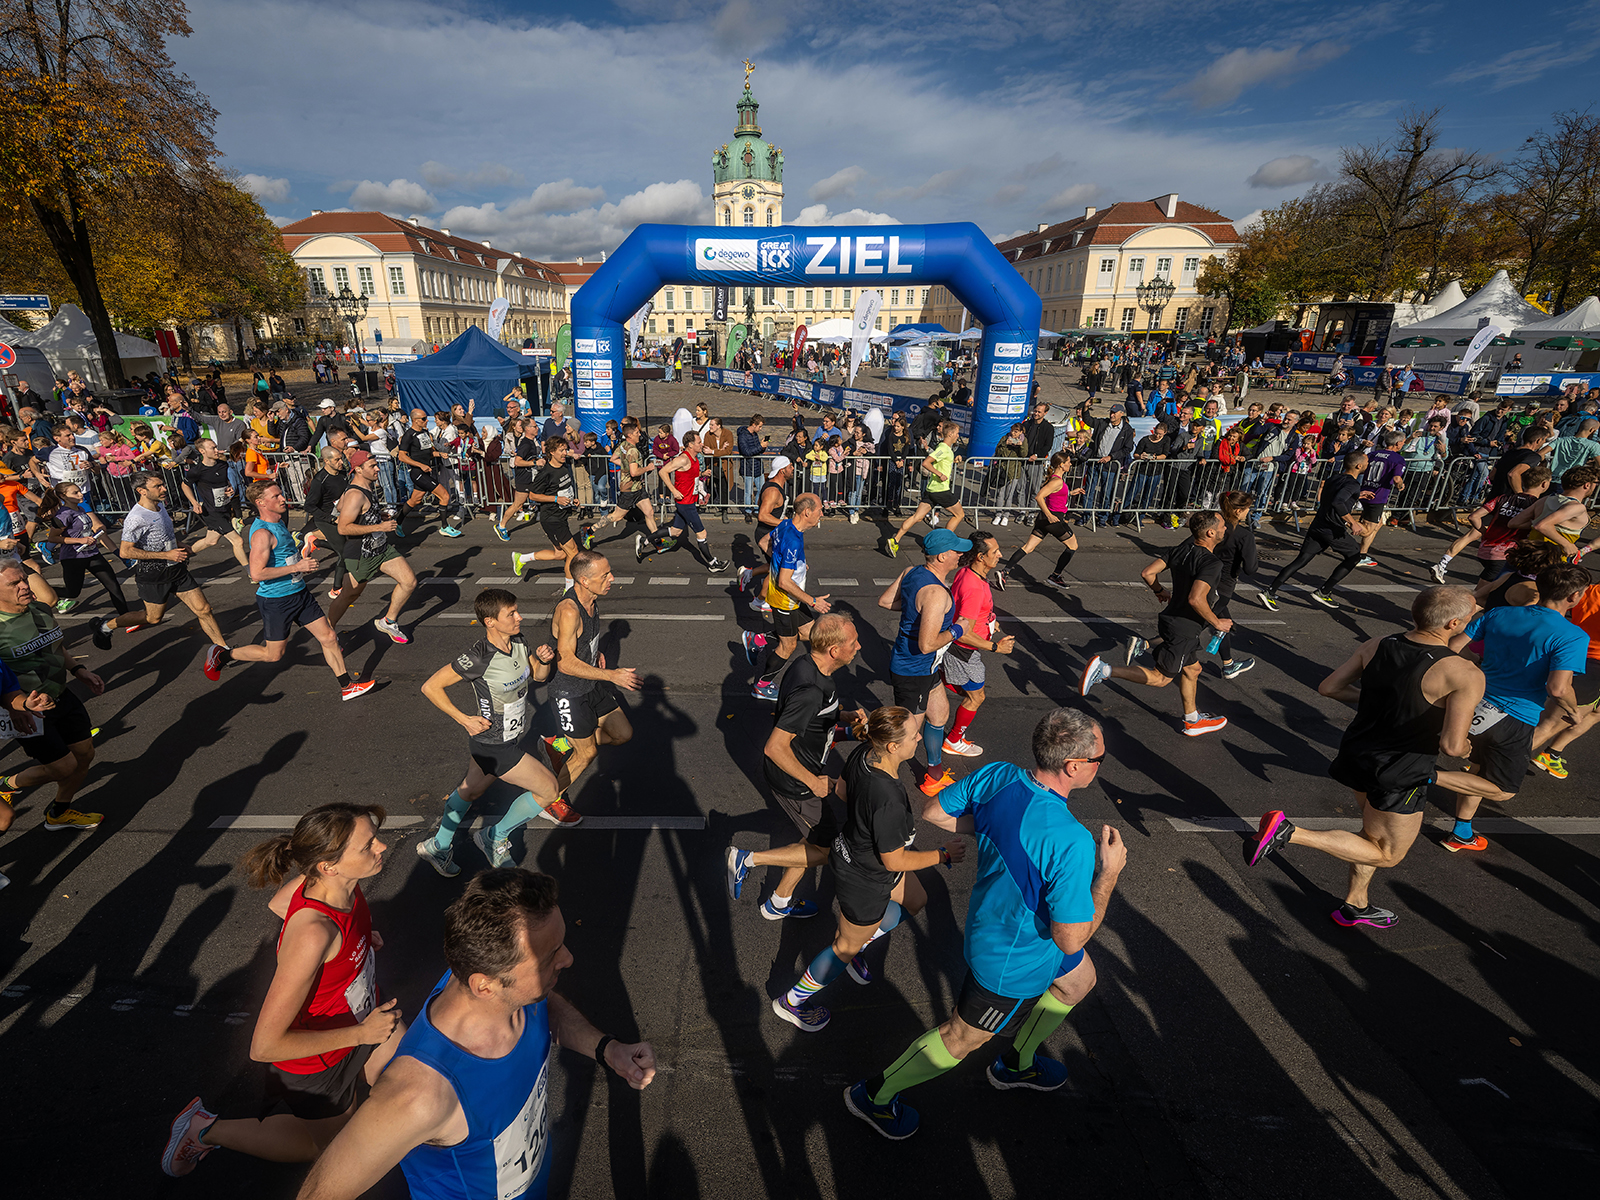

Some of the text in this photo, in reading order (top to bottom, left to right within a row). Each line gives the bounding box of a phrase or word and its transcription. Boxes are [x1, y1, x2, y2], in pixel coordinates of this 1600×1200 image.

[718, 249, 750, 260] degewo
[805, 236, 912, 274] ZIEL
[863, 299, 875, 321] degewo
[796, 330, 805, 350] REWE
[1367, 460, 1385, 482] 10
